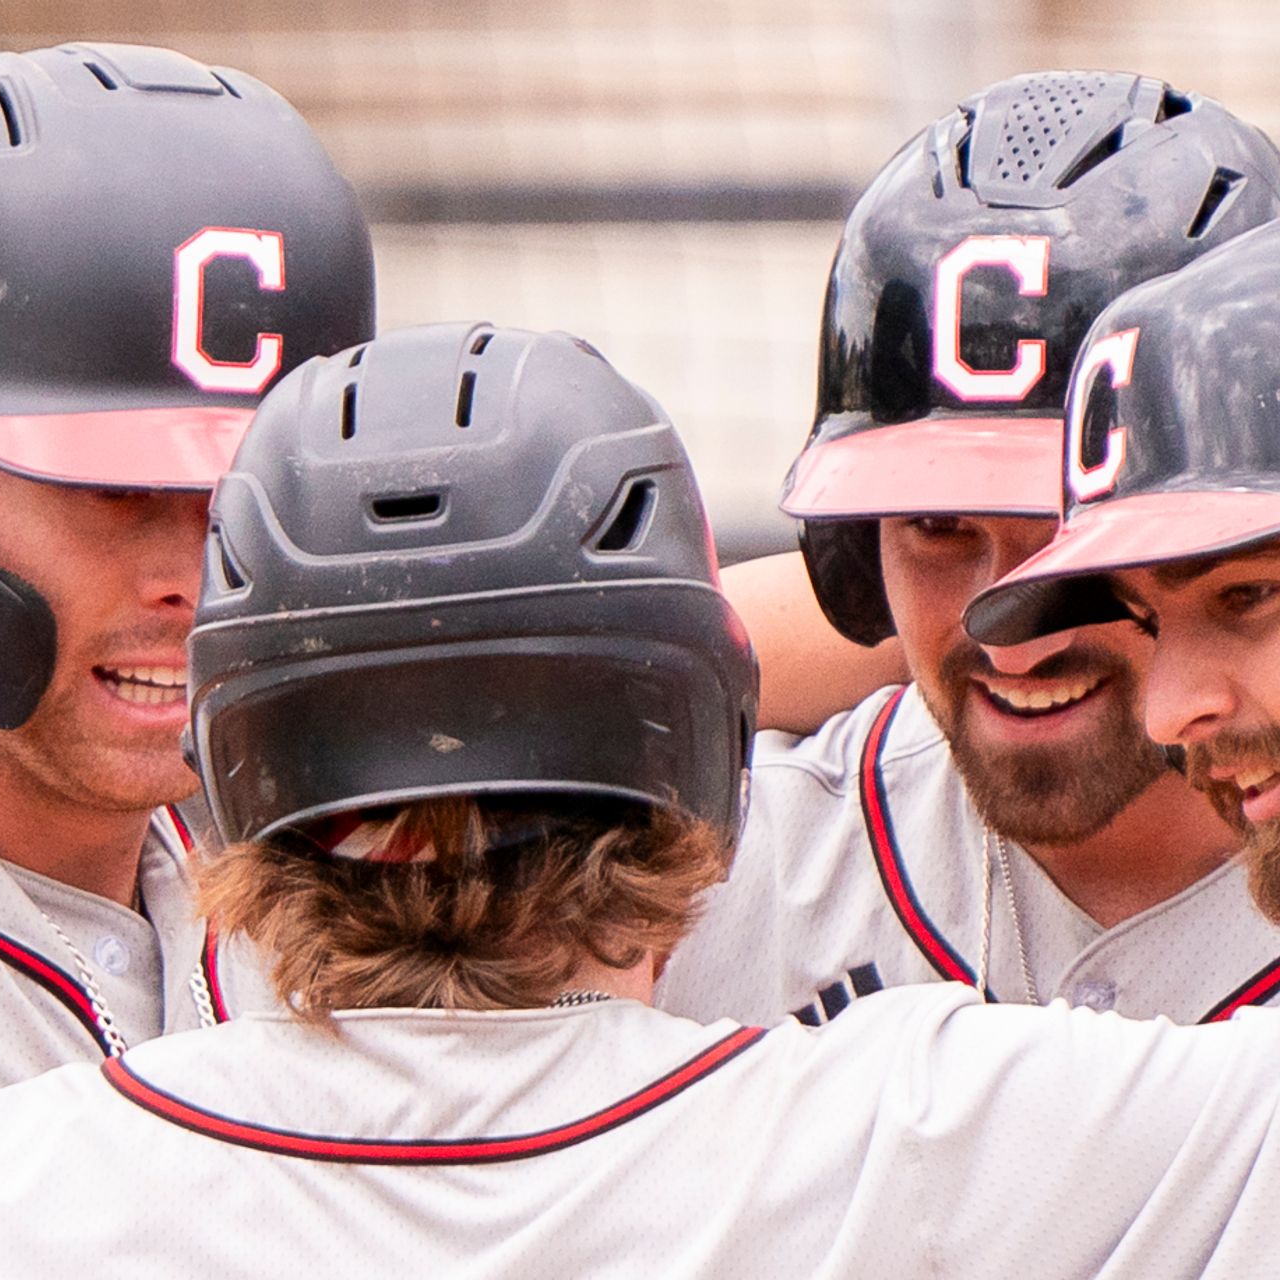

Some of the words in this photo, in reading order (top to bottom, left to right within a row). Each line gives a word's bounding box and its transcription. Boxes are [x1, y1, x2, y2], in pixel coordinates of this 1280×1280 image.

[171, 226, 286, 394] C
[932, 235, 1051, 402] C
[1070, 327, 1140, 503] C
